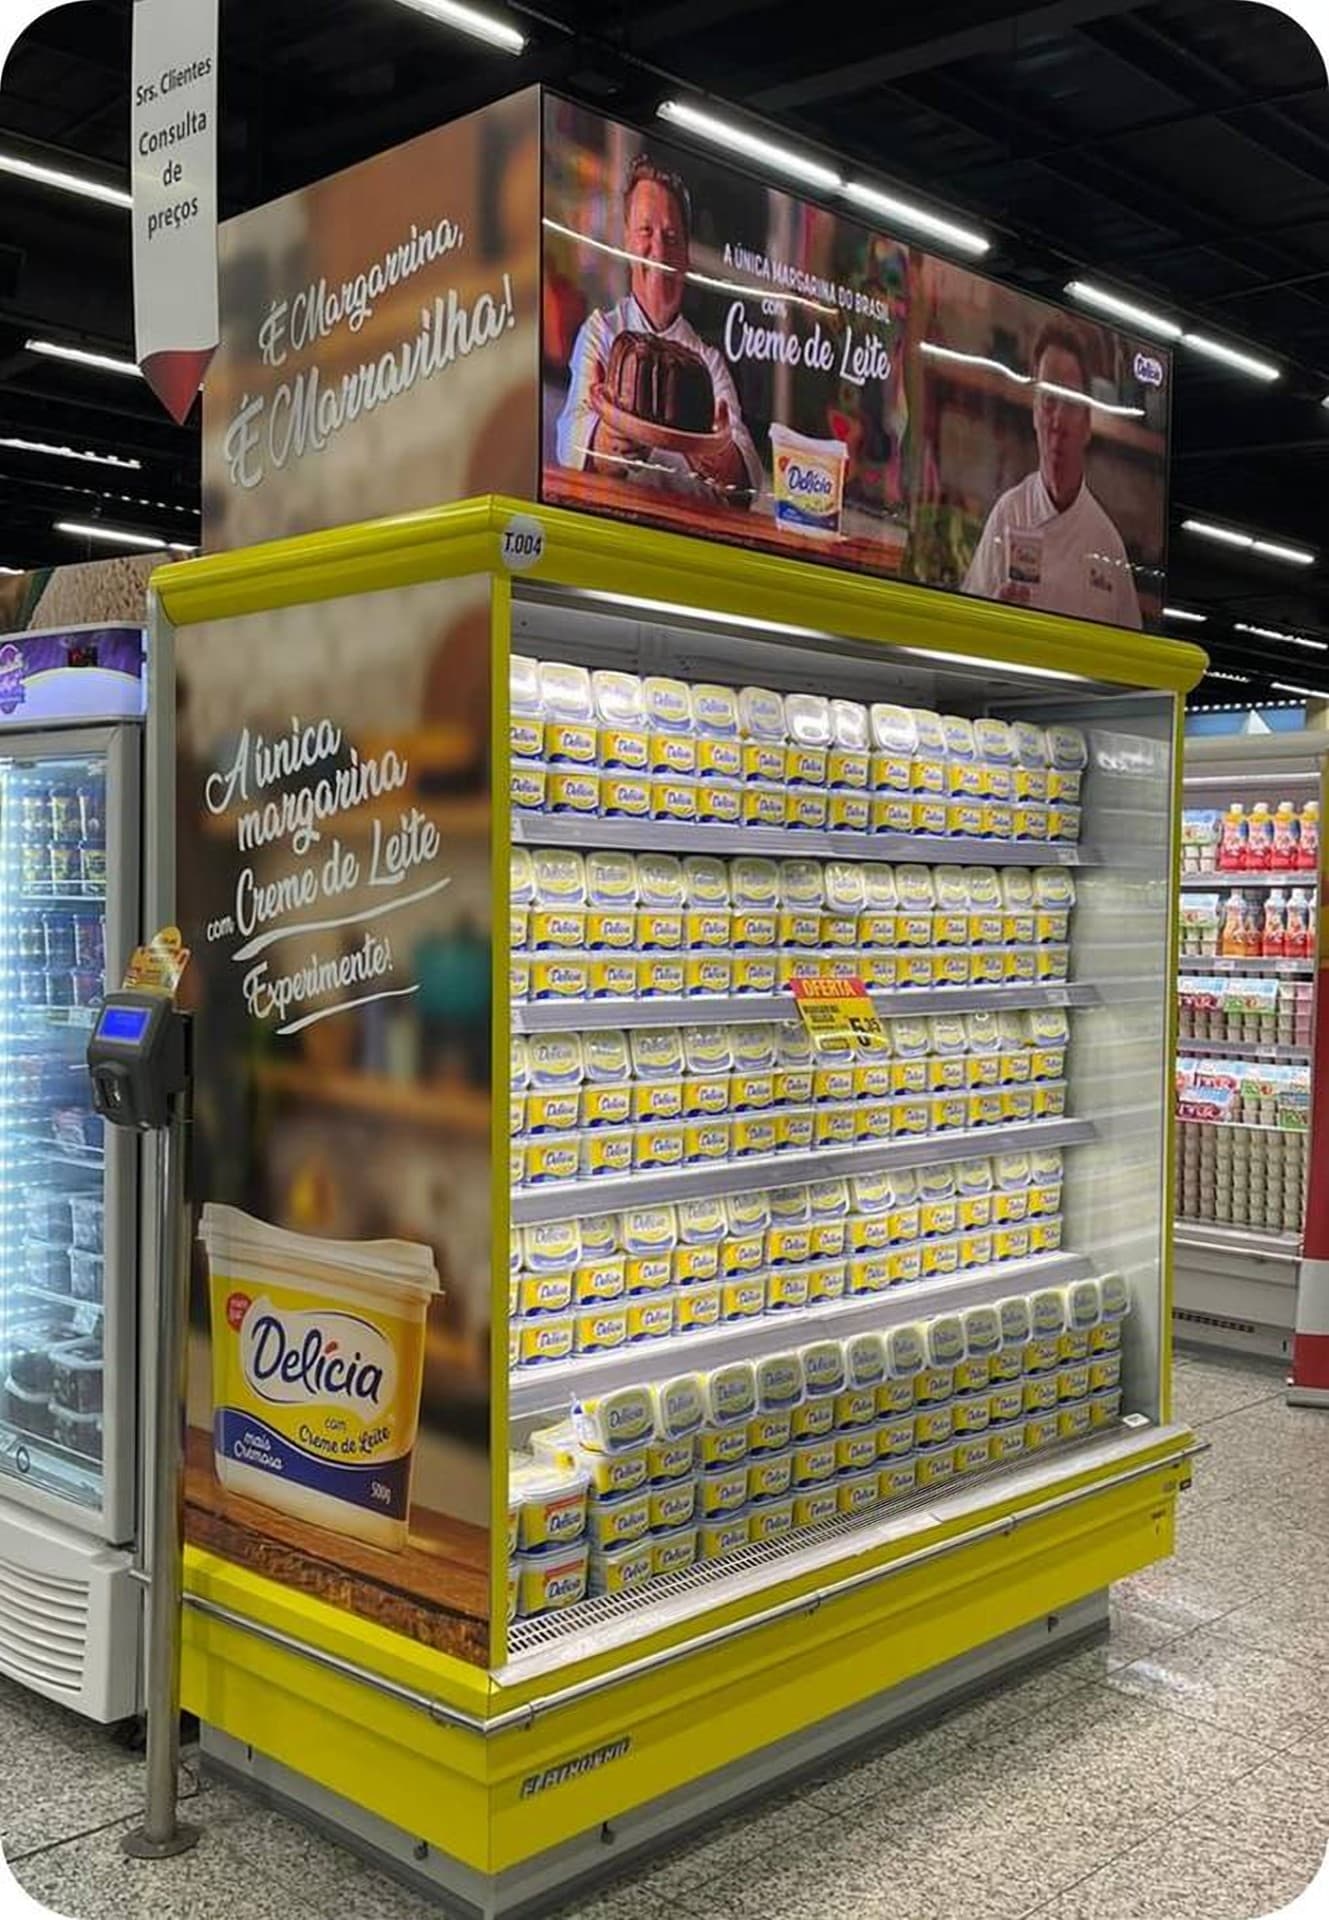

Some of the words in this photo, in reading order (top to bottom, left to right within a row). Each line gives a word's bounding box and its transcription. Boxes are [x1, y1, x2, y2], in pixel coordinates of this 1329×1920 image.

[136, 85, 158, 107] Srs.
[160, 58, 211, 95] Clientes
[139, 111, 206, 156] Consulta
[163, 160, 182, 186] de
[148, 197, 198, 240] preços
[723, 242, 732, 266] A
[772, 261, 836, 304] MARGARINA
[839, 285, 853, 309] DO
[855, 291, 890, 324] BRASIL
[724, 300, 802, 365] Creme
[804, 322, 834, 371] de
[839, 325, 891, 386] Leite
[504, 532, 542, 555] T.004
[205, 728, 249, 815] A
[254, 715, 341, 789] única
[237, 747, 408, 855] margarina
[207, 916, 233, 942] com
[236, 868, 319, 936] Creme
[321, 839, 360, 895] de
[369, 807, 440, 886] Leite
[243, 932, 393, 1021] Experimente!
[802, 979, 857, 997] OFERTA
[250, 1315, 383, 1404] Delícia
[243, 1431, 271, 1452] mais
[299, 1425, 338, 1453] Creme
[341, 1437, 357, 1454] de
[358, 1426, 391, 1454] Leite
[324, 1417, 346, 1430] com
